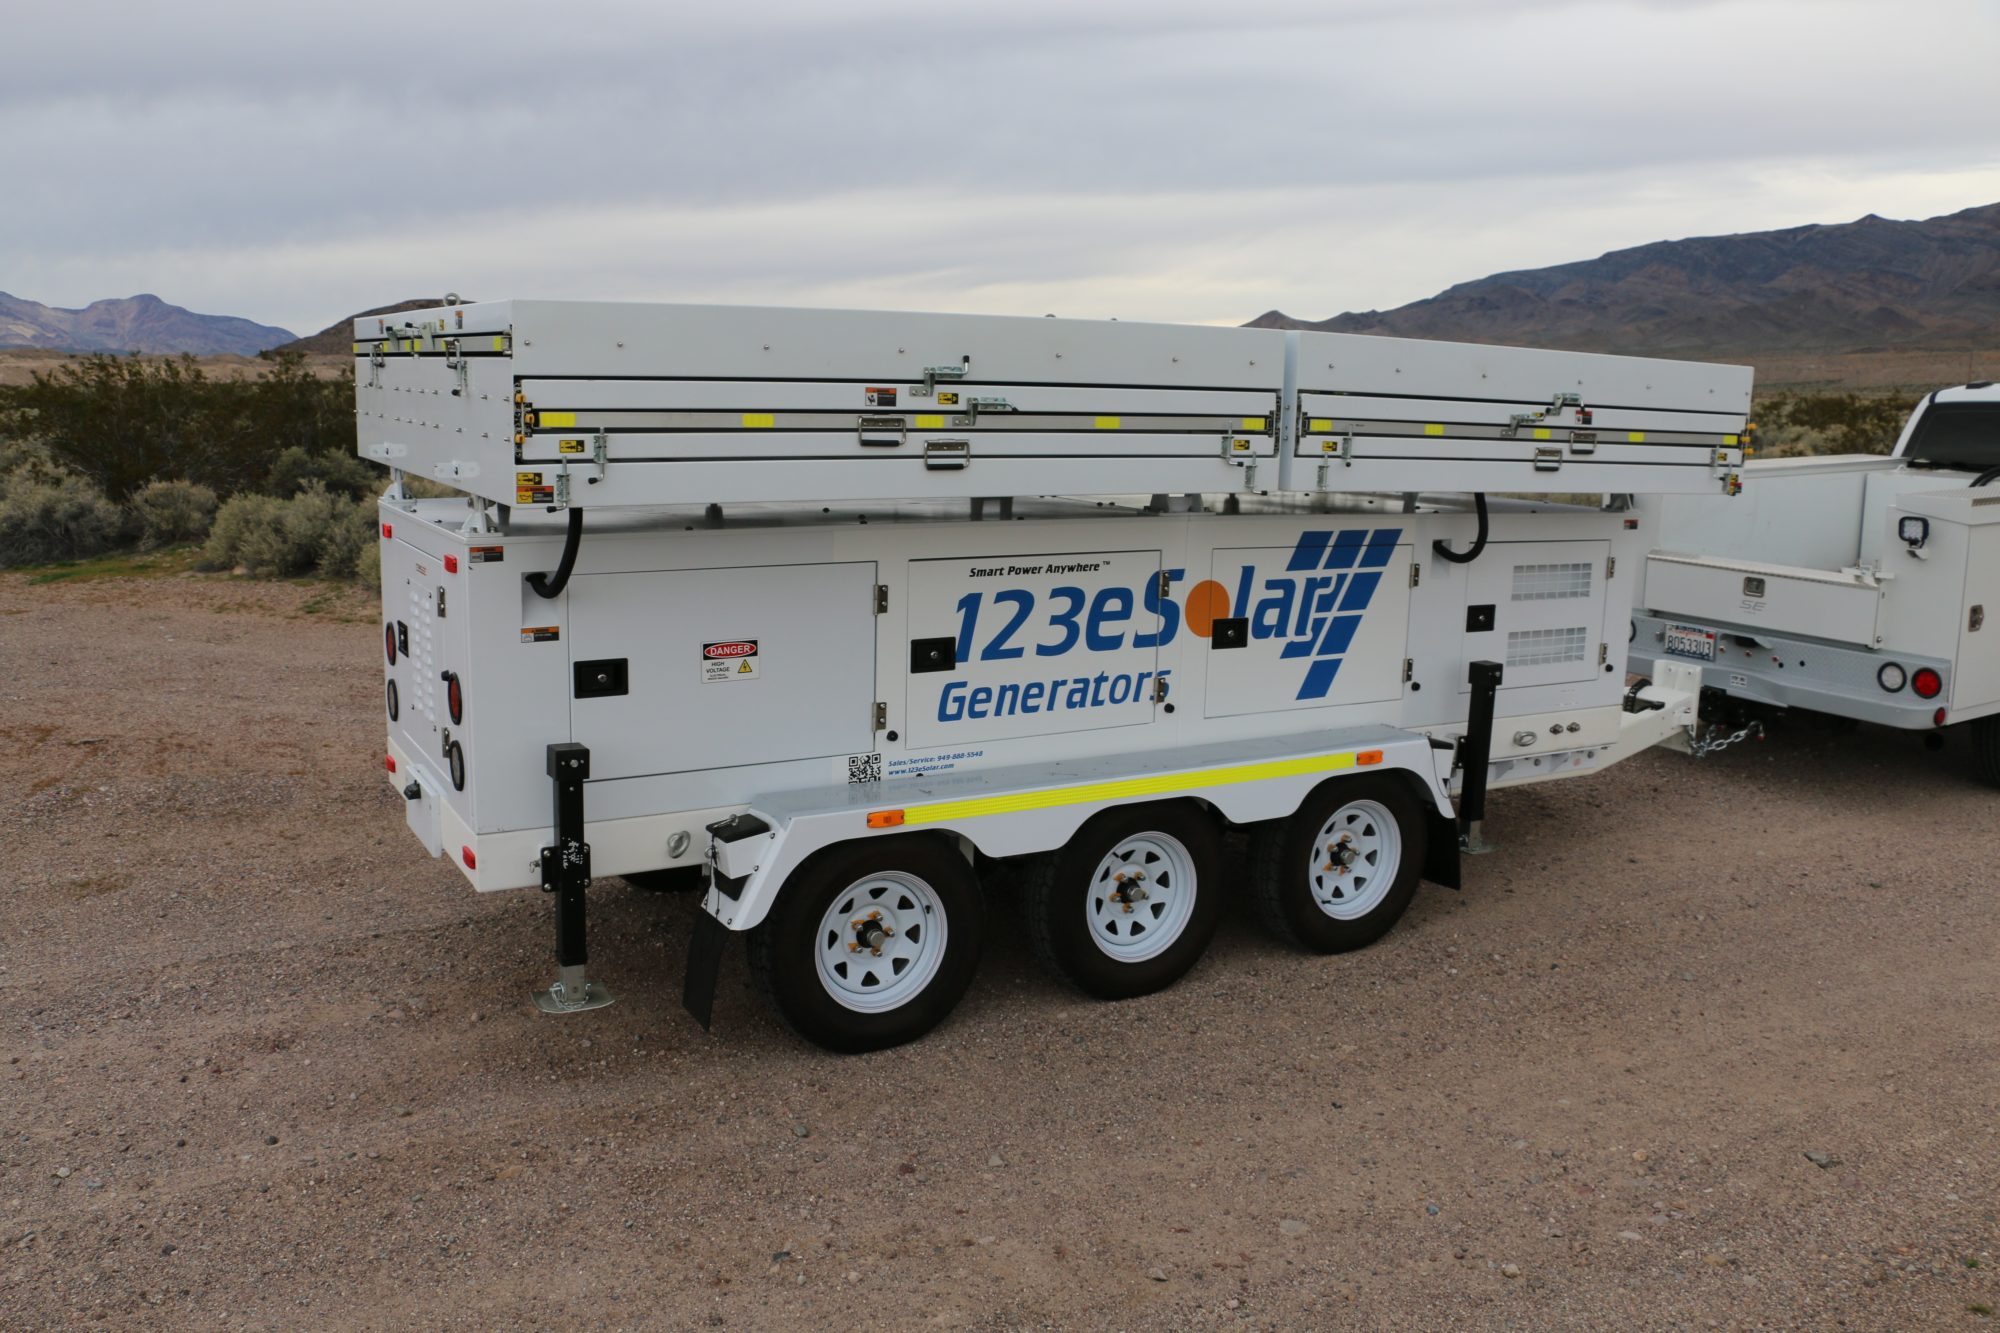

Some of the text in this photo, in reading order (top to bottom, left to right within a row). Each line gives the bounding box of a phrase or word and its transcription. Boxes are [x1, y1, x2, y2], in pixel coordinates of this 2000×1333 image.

[969, 567, 1005, 578] Smart
[1007, 565, 1044, 576] Power
[1045, 562, 1100, 575] Anywhere
[710, 645, 751, 656] DANGER
[706, 666, 730, 674] VOLTAGE
[937, 669, 1172, 723] Generators
[888, 750, 984, 767] Sales/Service: 949-888-5548
[888, 763, 955, 776] www.123eSolar.com
